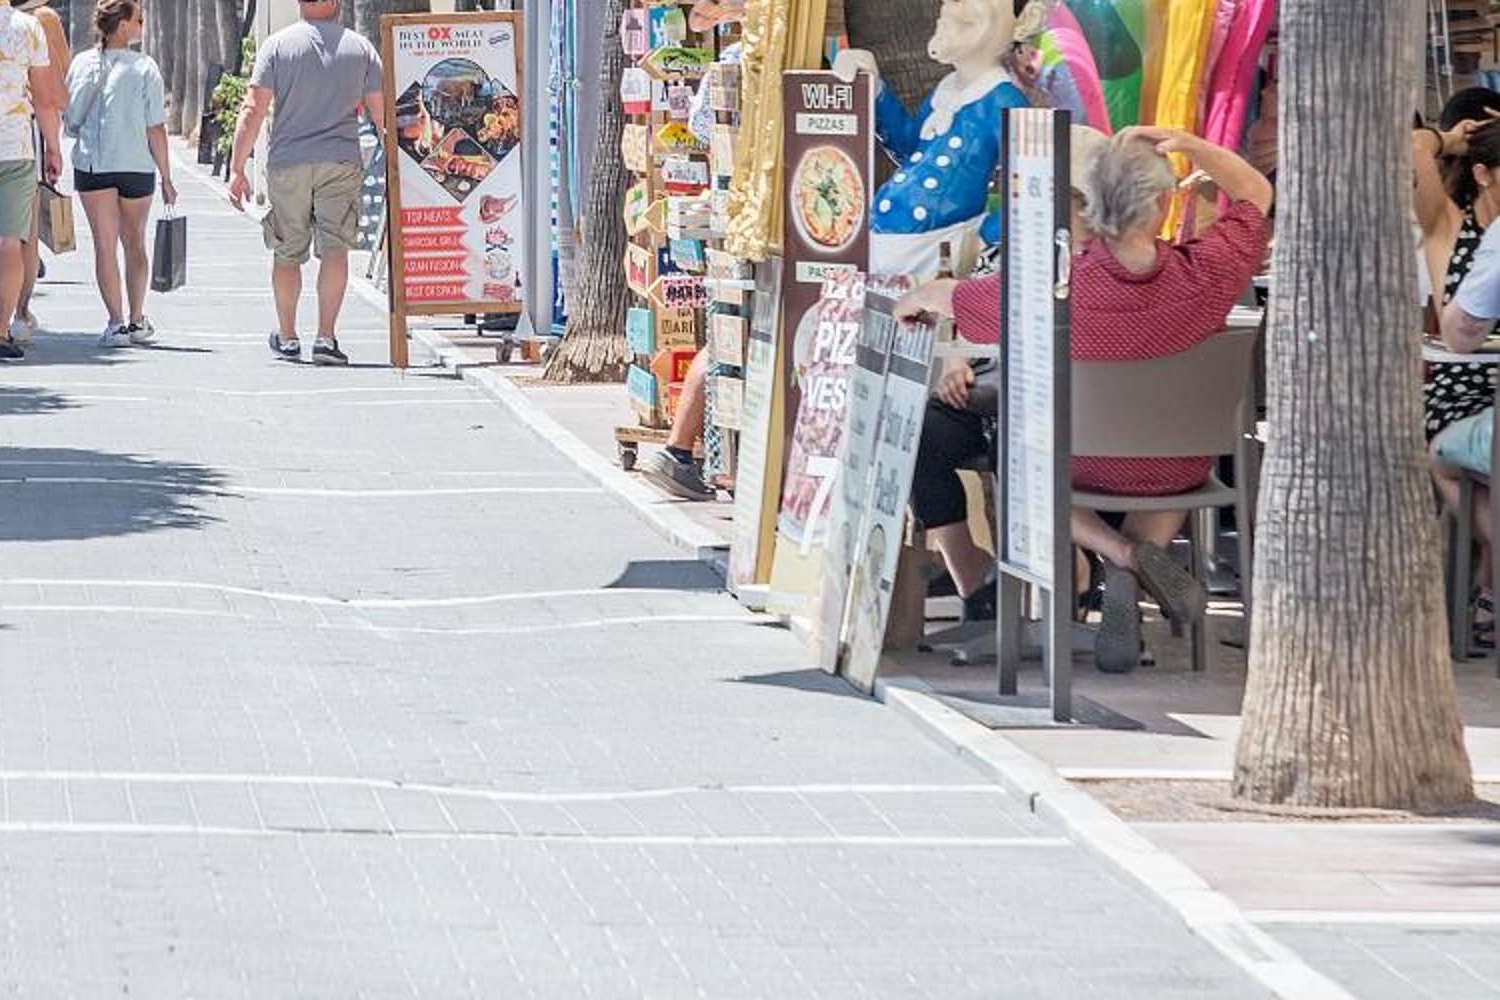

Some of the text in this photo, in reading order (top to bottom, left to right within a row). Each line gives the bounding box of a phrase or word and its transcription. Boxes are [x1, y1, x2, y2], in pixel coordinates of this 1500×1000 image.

[427, 26, 452, 40] OX
[801, 83, 853, 110] WI-FI
[813, 320, 860, 364] PIZ
[806, 374, 847, 410] VES
